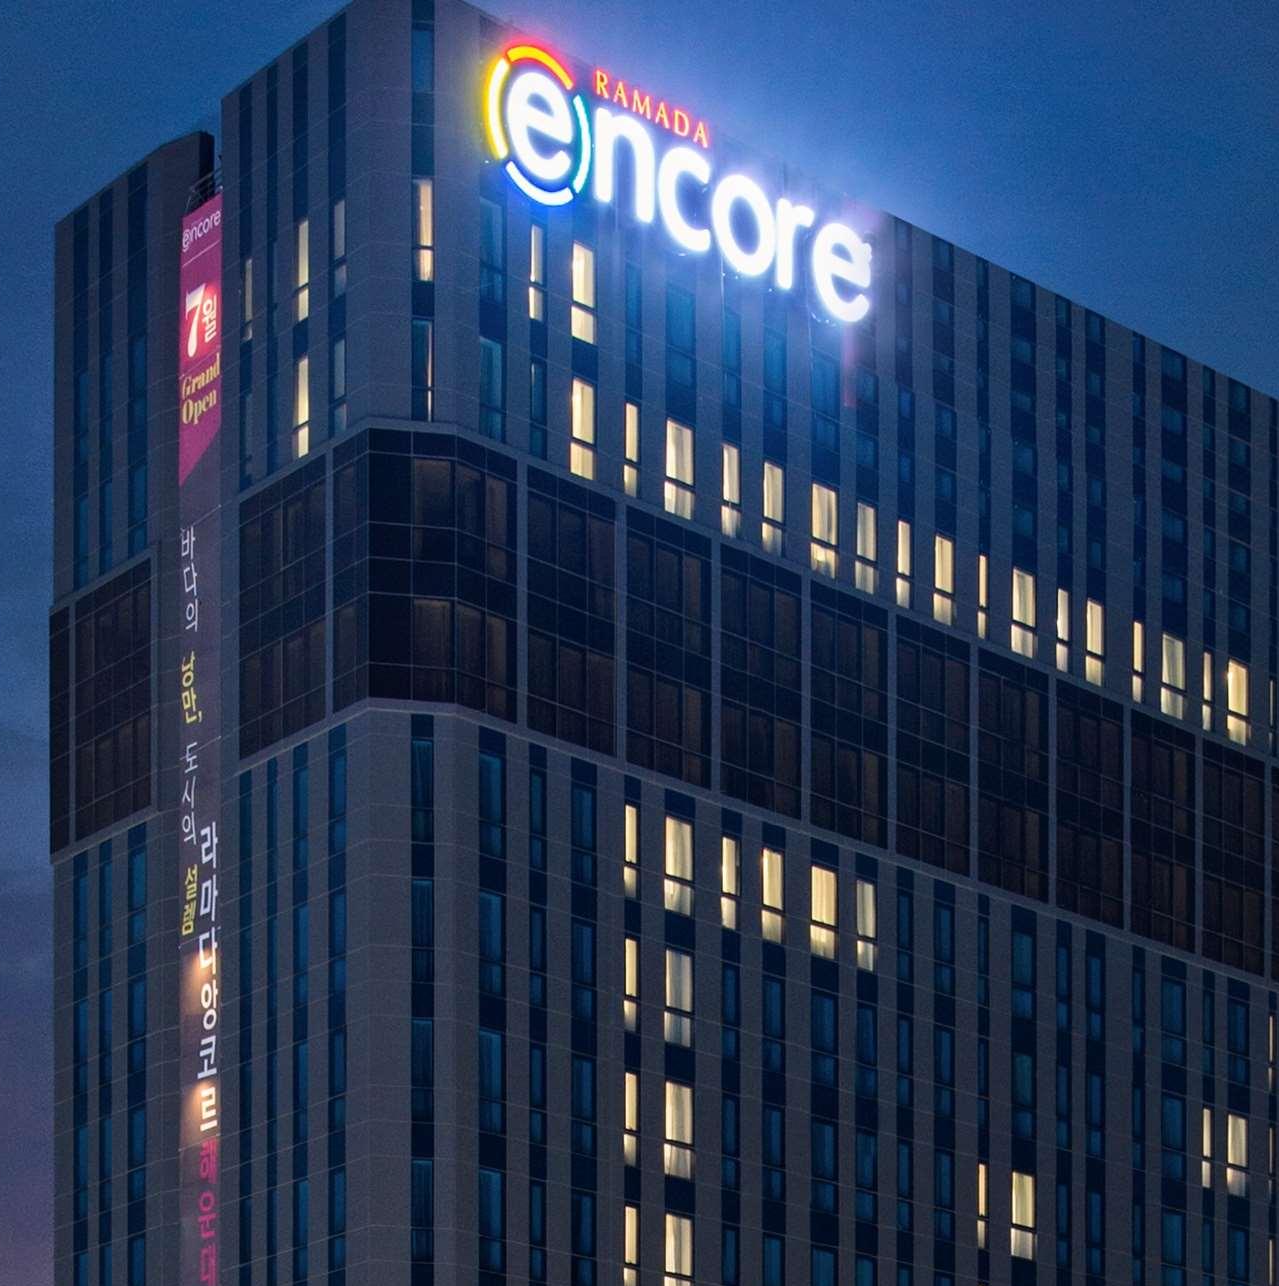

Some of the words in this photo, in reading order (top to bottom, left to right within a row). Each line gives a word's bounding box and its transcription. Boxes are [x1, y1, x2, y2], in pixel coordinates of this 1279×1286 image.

[596, 69, 709, 148] RAMADA
[182, 209, 221, 252] encore
[504, 72, 871, 323] encore
[182, 354, 220, 397] Grand
[182, 389, 217, 424] Open
[181, 526, 198, 632] 바다의
[181, 742, 198, 845] 도시의
